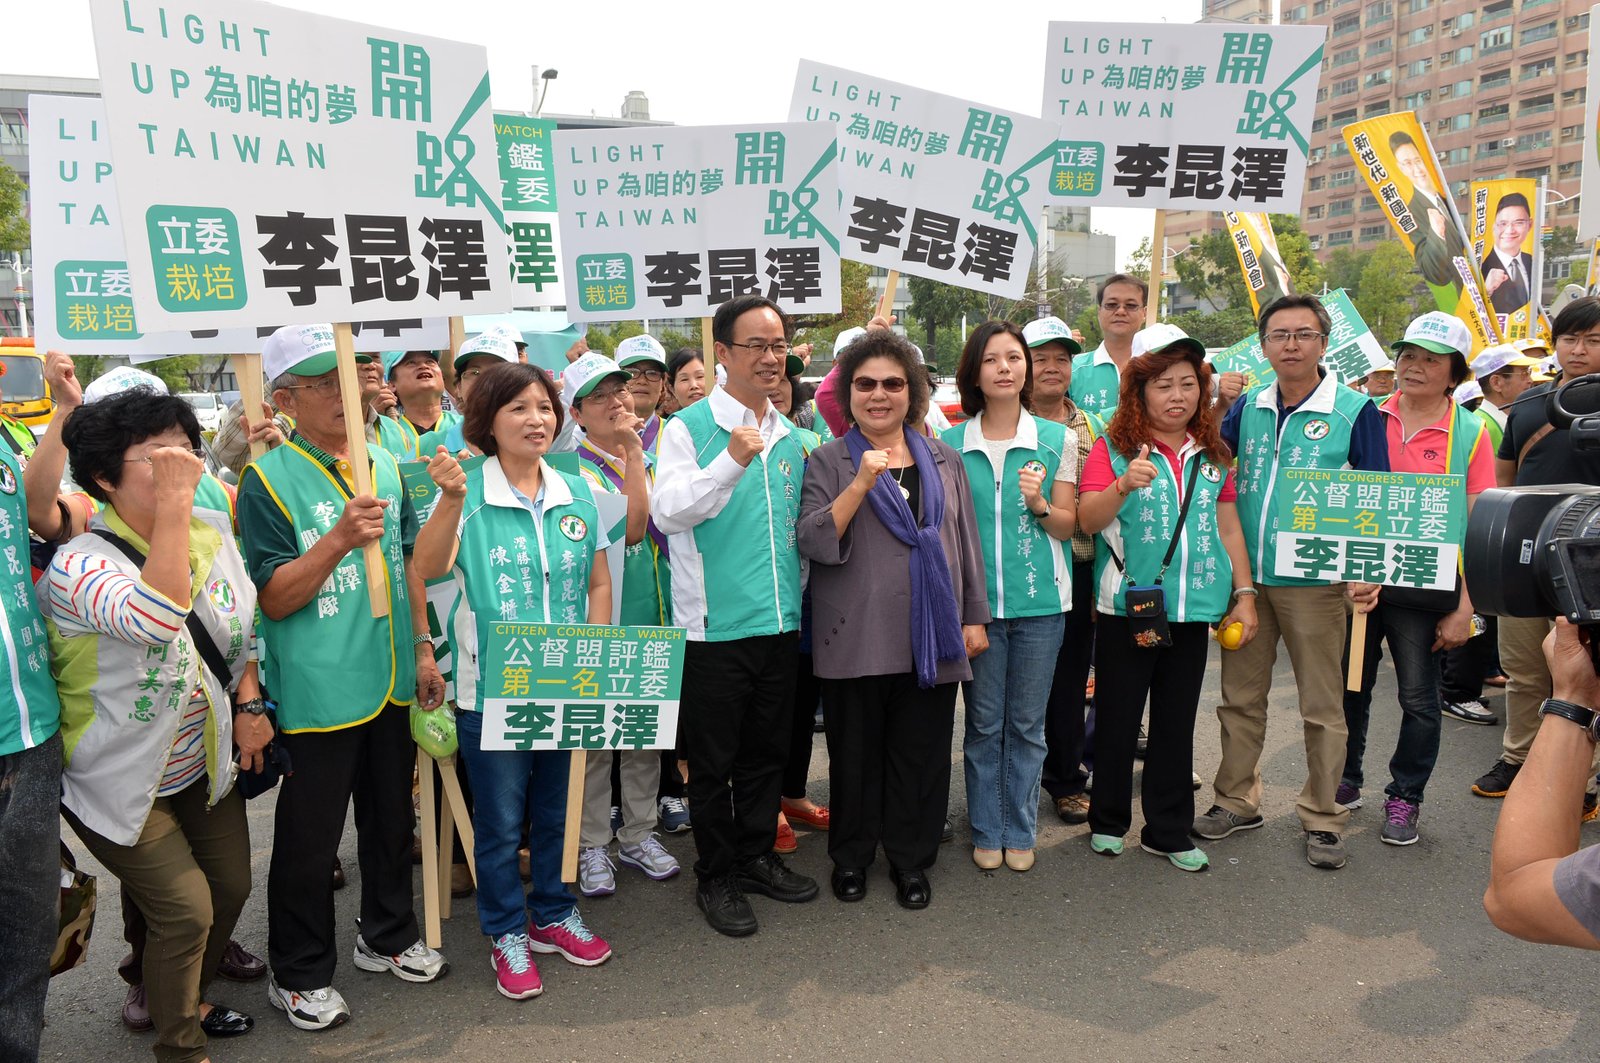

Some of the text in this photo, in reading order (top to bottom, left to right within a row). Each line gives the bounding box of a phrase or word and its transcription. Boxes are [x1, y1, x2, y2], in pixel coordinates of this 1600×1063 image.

[124, 0, 270, 57] LIGHT
[1063, 37, 1153, 55] LIGHT
[131, 62, 358, 125] UP 為咱的夢
[812, 76, 901, 112] LIGHT
[1061, 64, 1206, 92] UP 為咱的夢
[1059, 99, 1174, 118] TAIWAN
[138, 123, 327, 170] TAIWAN
[846, 112, 950, 156] 為咱的夢
[571, 144, 664, 164] LIGHT
[1057, 147, 1098, 168] 立委
[59, 160, 113, 183] UP
[573, 168, 724, 199] UP 為咱的夢
[1055, 172, 1095, 192] 栽培
[1113, 143, 1288, 203] 李昆澤
[1353, 133, 1416, 233] 新世代 新國會
[576, 208, 697, 228] TAIWAN
[157, 215, 230, 257] 立委
[847, 195, 1019, 283] 李昆澤
[255, 211, 491, 307] 李昆澤
[582, 258, 627, 282] 立委
[1234, 230, 1263, 288] 新國會
[166, 262, 235, 303] 栽培
[645, 247, 822, 307] 李昆澤
[585, 284, 628, 306] 栽培
[67, 304, 134, 333] 栽培
[1286, 470, 1460, 487] CITIZEN CONGRESS WATCH
[1293, 481, 1450, 514] 公督盟評鑑
[1197, 488, 1212, 555] 李昆澤
[1291, 505, 1448, 541] 第一名立委
[1293, 536, 1439, 588] 李昆澤
[496, 625, 681, 640] CITIZEN CONGRESS WATCH
[503, 637, 672, 669] 公督盟評鑑
[501, 667, 669, 698] 第一名立委
[503, 702, 660, 750] 李昆澤
